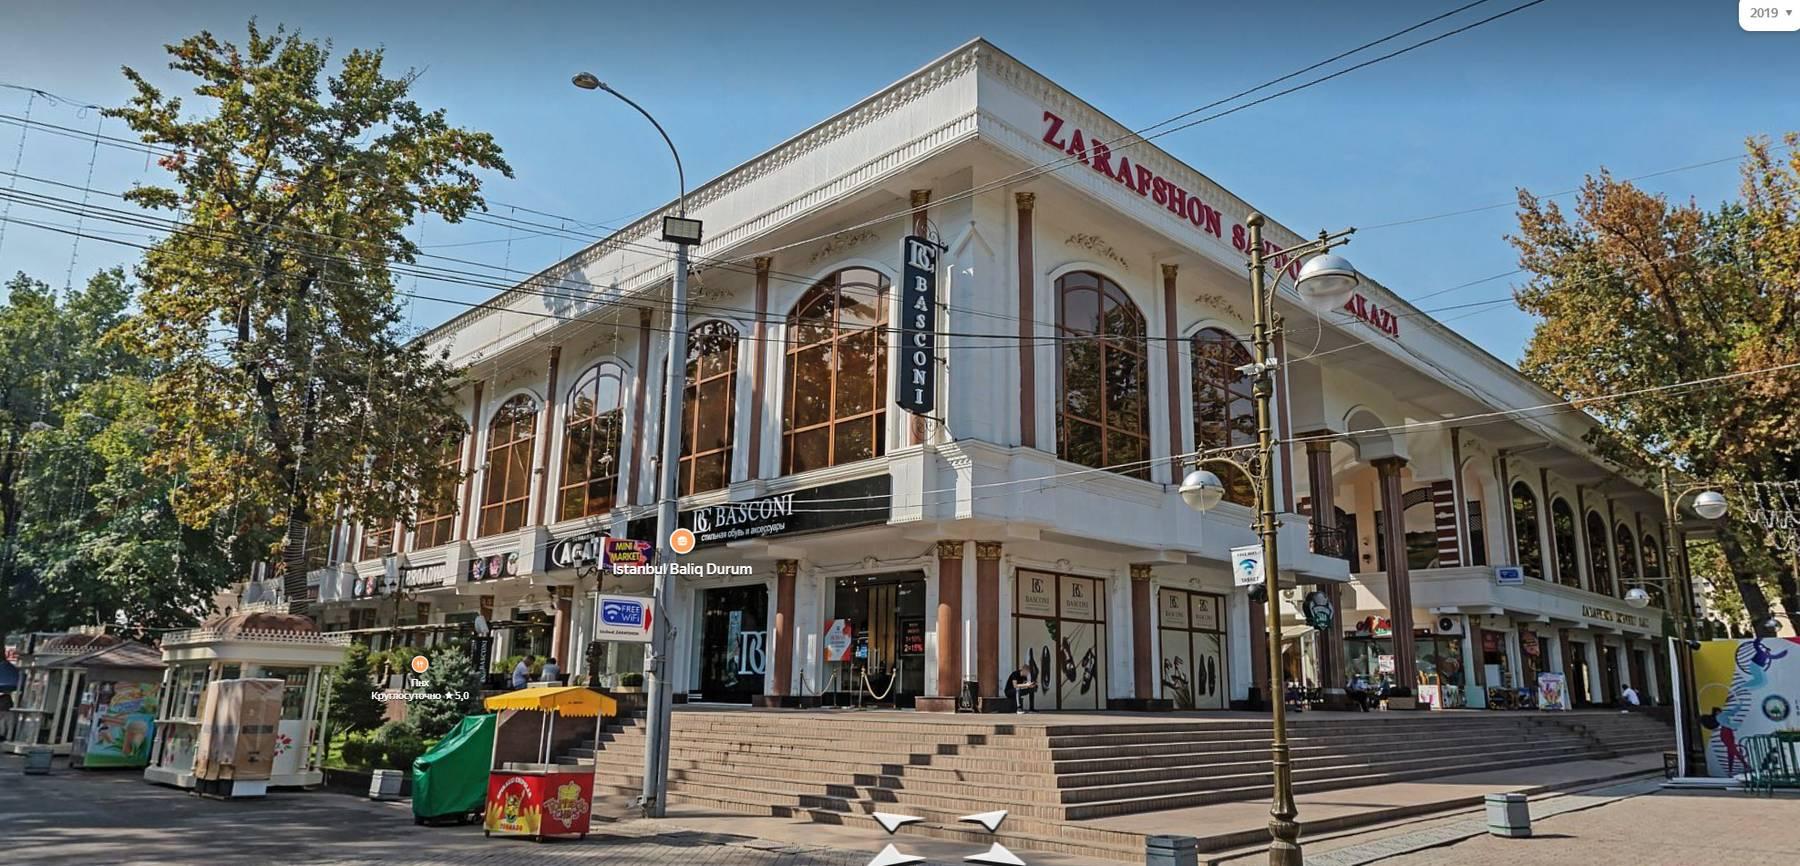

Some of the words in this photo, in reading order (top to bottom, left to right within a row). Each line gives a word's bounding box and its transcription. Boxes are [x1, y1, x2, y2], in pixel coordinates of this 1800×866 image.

[1042, 111, 1222, 239] ZARAFSHON
[912, 275, 928, 405] BASCONI
[715, 493, 795, 527] BASCONI
[727, 527, 745, 539] обувь
[616, 542, 633, 551] MINI
[611, 551, 640, 562] MARKET
[621, 604, 640, 613] FREE
